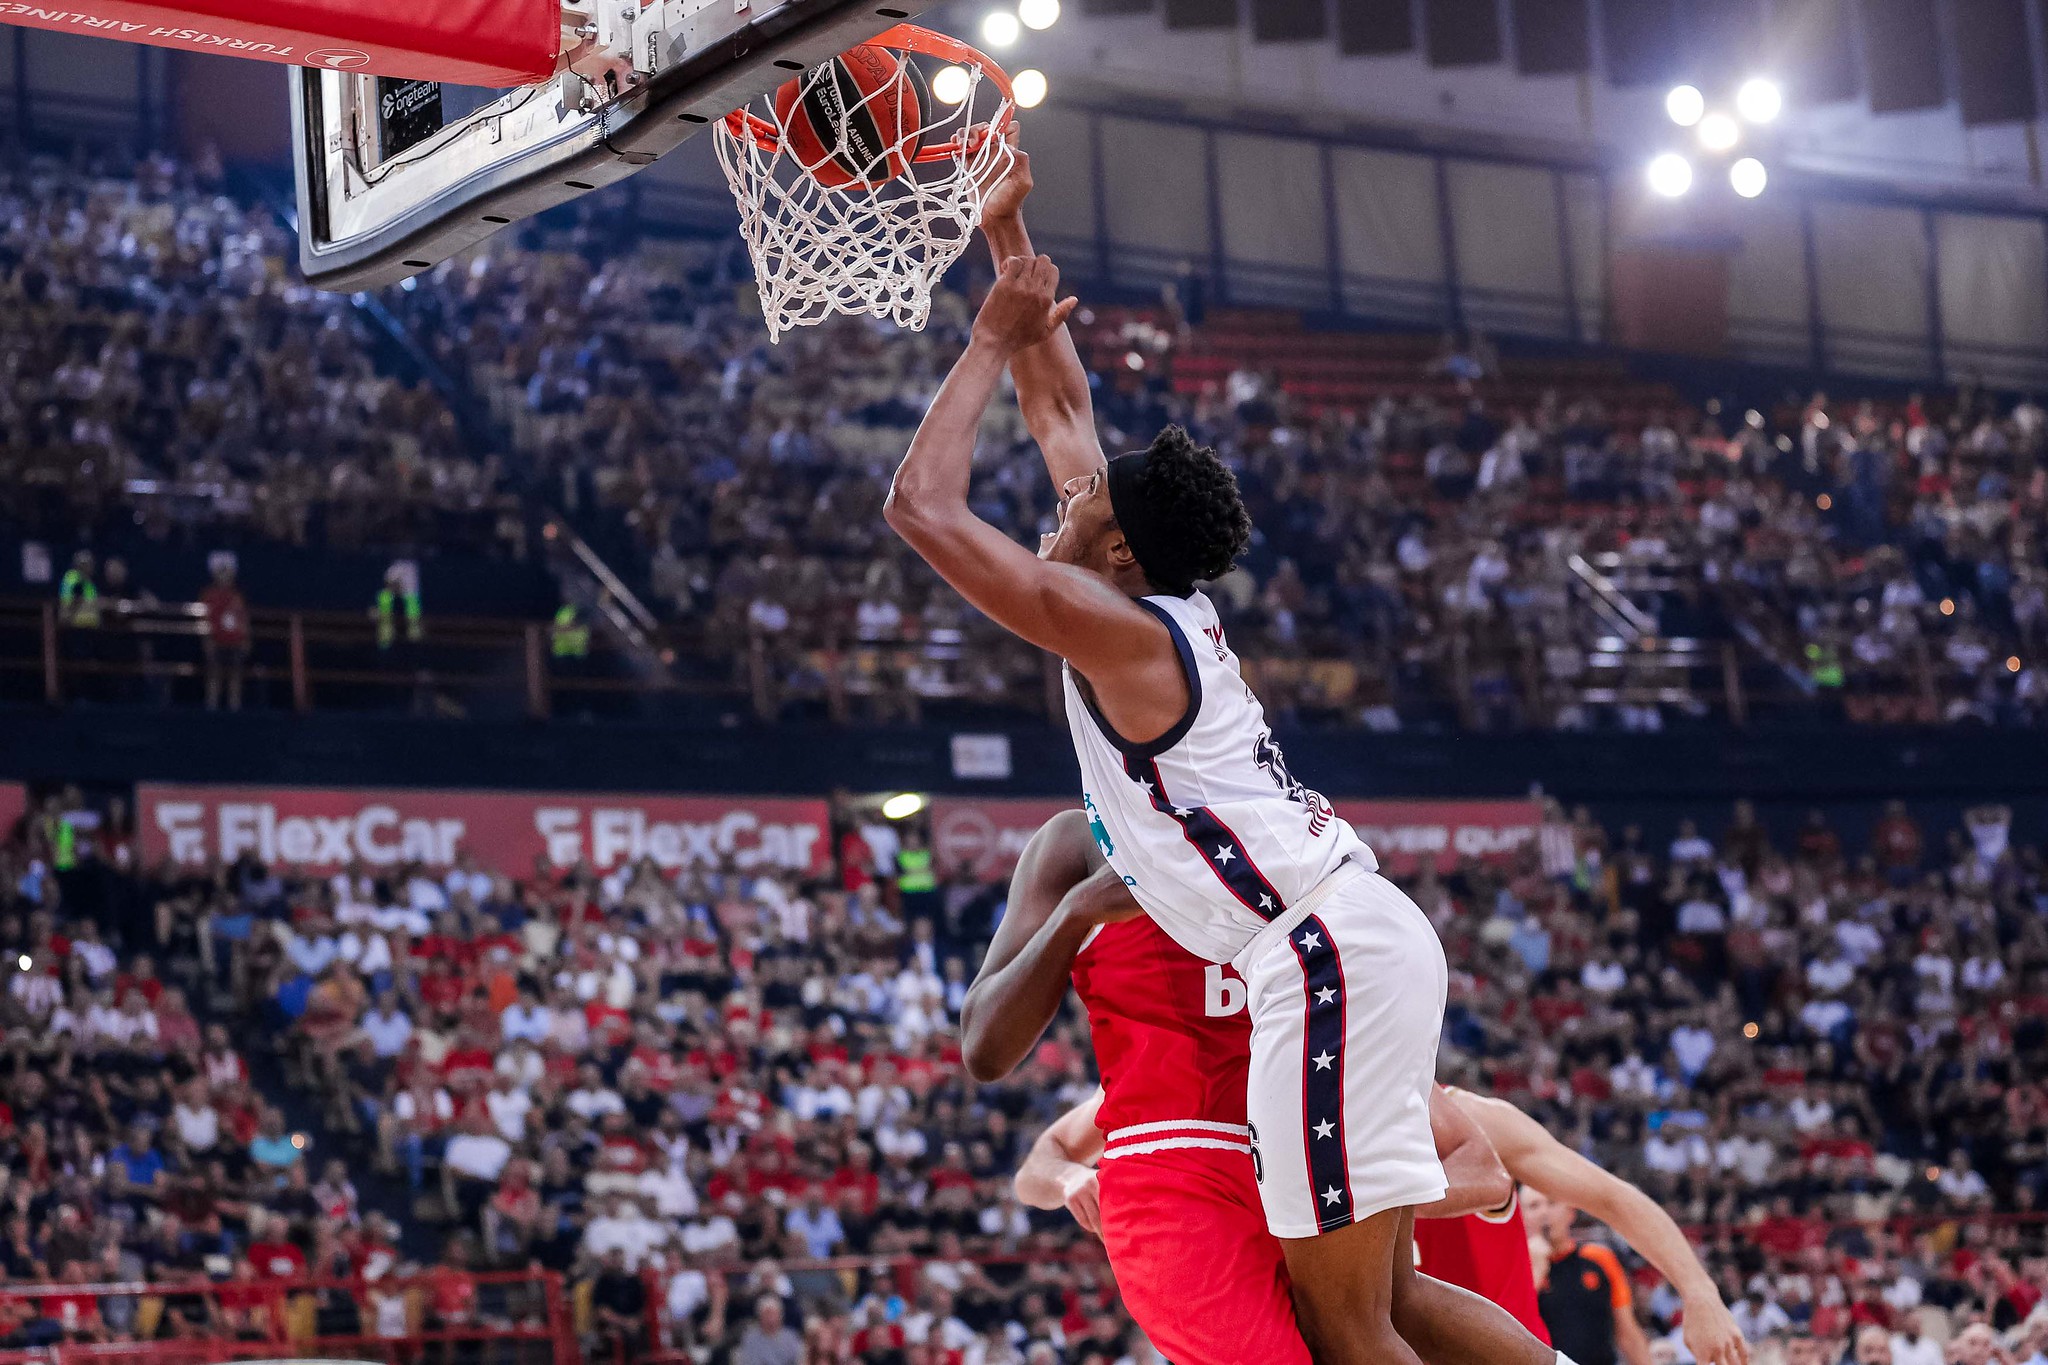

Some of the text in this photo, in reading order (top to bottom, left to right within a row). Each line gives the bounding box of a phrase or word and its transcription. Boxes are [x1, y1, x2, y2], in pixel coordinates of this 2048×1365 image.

[0, 2, 294, 56] TURKISH AIRLINES
[847, 126, 875, 165] AIRLINE
[218, 803, 465, 864] FlexCar
[591, 807, 820, 869] FlexCar
